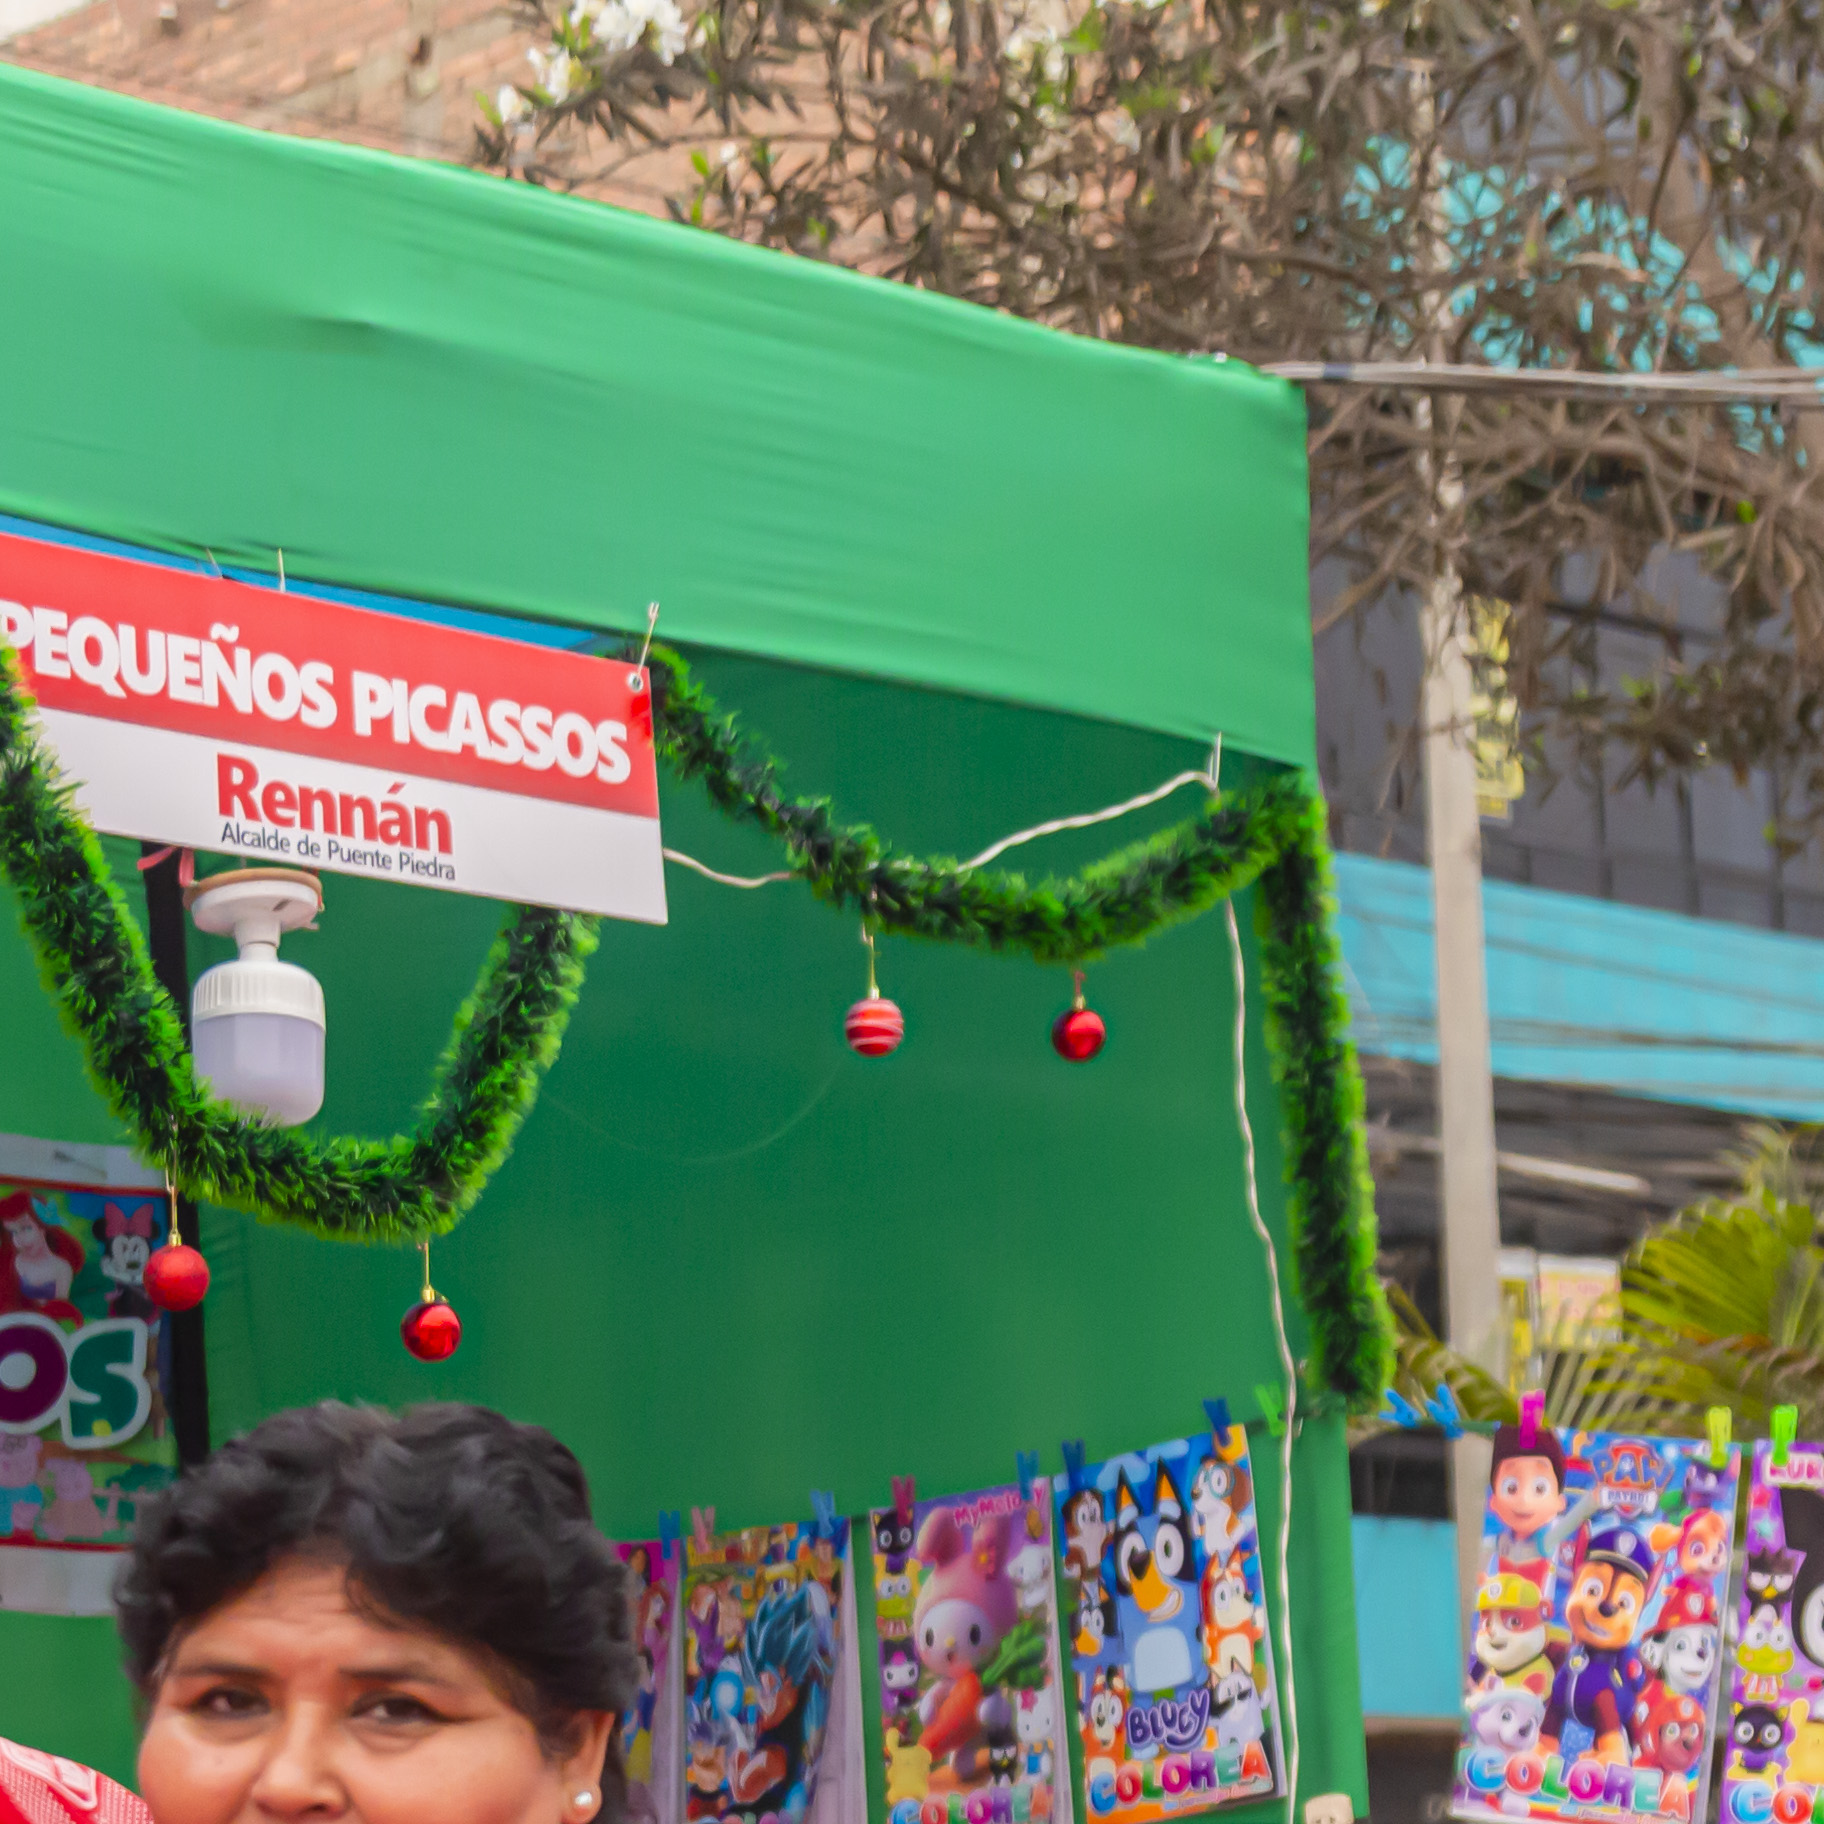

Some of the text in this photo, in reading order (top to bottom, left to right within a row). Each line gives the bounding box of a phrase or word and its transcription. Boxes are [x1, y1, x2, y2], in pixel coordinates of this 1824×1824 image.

[353, 670, 632, 785] PICASSOS
[217, 752, 453, 855] Rennán
[221, 821, 455, 881] Alcalde de Puente Piedra
[1090, 1740, 1271, 1815] COLOREA
[1465, 1750, 1691, 1819] COLOREA
